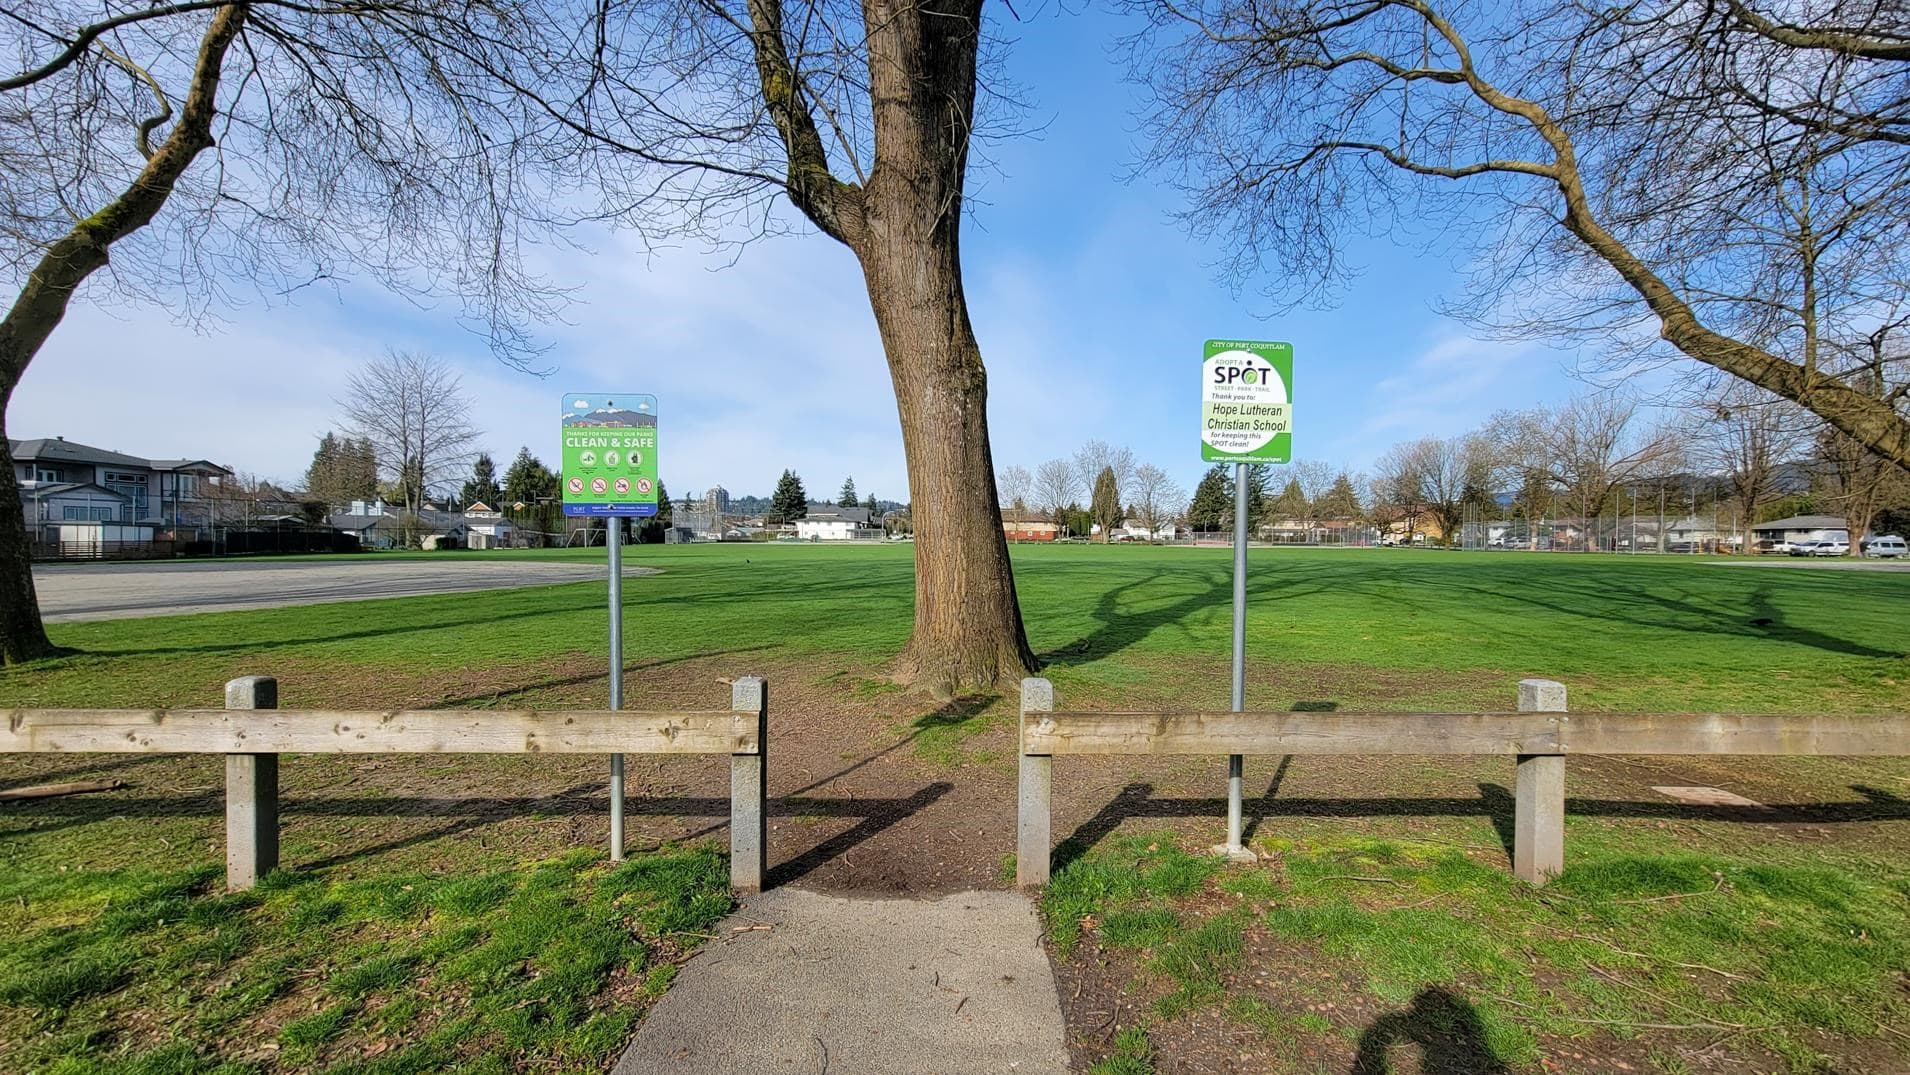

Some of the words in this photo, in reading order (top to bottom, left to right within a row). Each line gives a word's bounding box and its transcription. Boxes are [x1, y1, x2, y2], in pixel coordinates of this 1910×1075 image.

[1214, 366, 1271, 385] SPOT
[1212, 404, 1238, 417] Hope
[1240, 404, 1282, 416] Lutheran
[1207, 417, 1250, 430] Christian
[1253, 419, 1286, 432] School
[566, 437, 608, 448] CLEAN
[611, 437, 621, 448] &
[624, 437, 654, 448] SAFE
[1222, 432, 1248, 440] keeping
